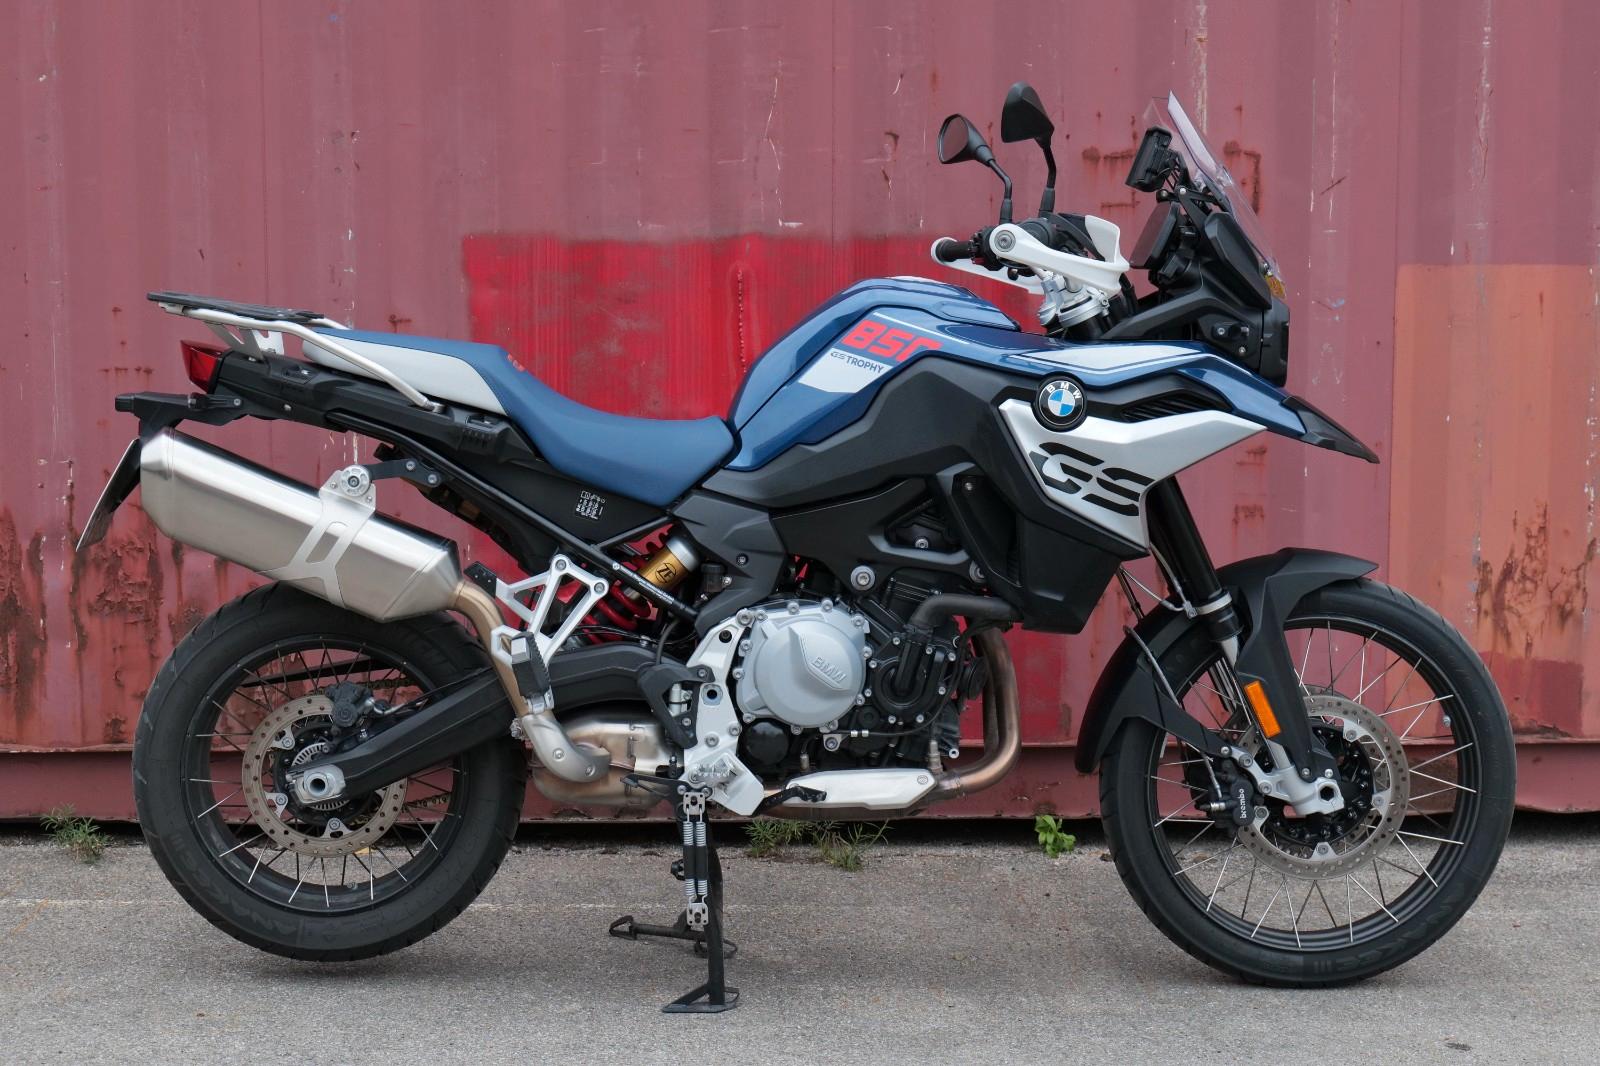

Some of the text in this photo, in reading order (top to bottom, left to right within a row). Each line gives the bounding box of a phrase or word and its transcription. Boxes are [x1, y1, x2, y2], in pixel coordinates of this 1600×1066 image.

[1046, 381, 1083, 399] BMW
[810, 656, 847, 685] BMW
[1236, 788, 1247, 819] brembo
